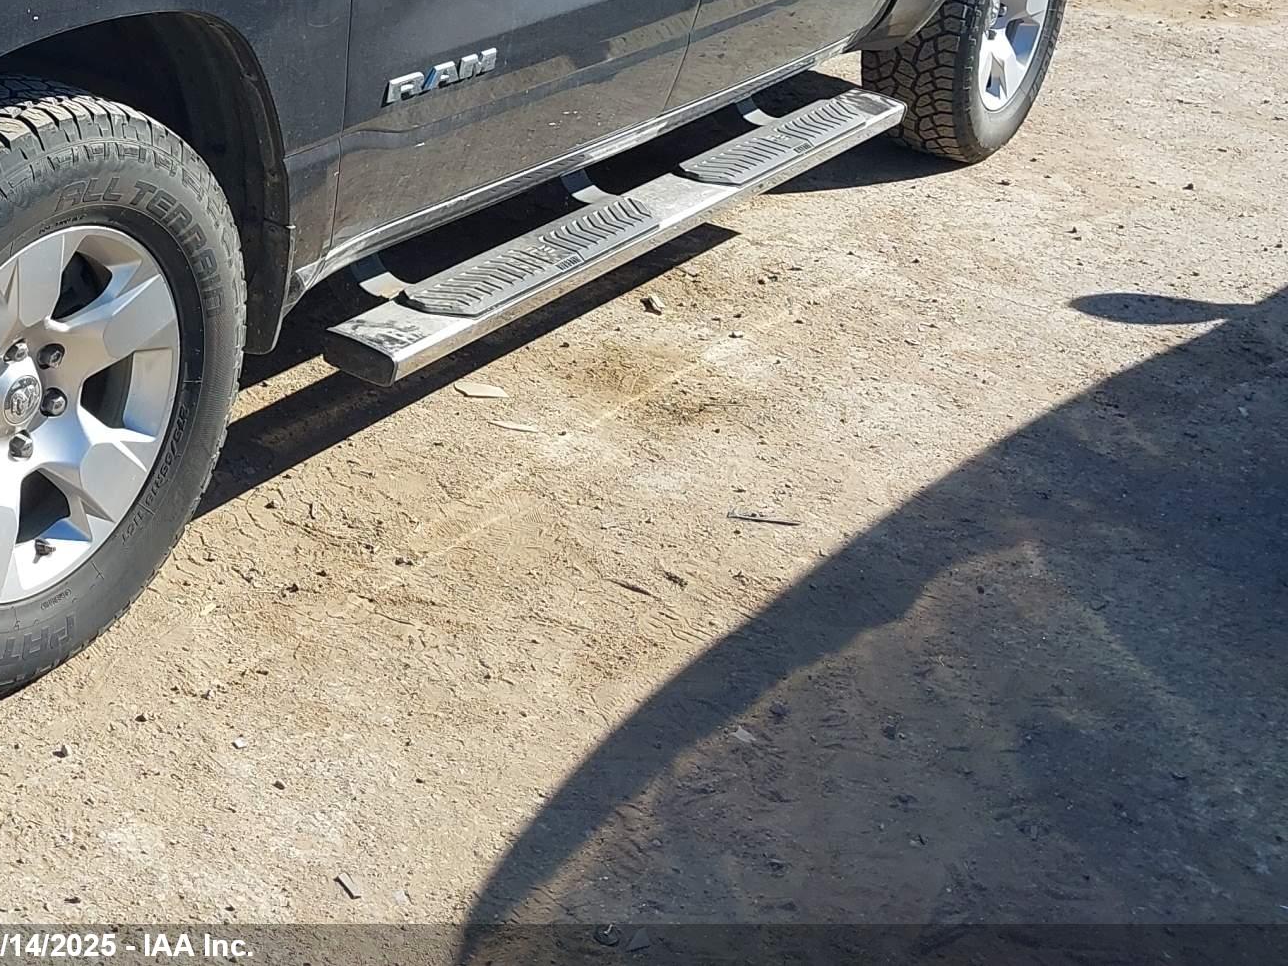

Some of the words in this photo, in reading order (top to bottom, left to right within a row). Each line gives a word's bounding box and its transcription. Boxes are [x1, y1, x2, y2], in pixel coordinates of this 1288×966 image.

[384, 47, 497, 105] RAM
[55, 177, 123, 213] ALL
[128, 180, 224, 318] TERRAIN
